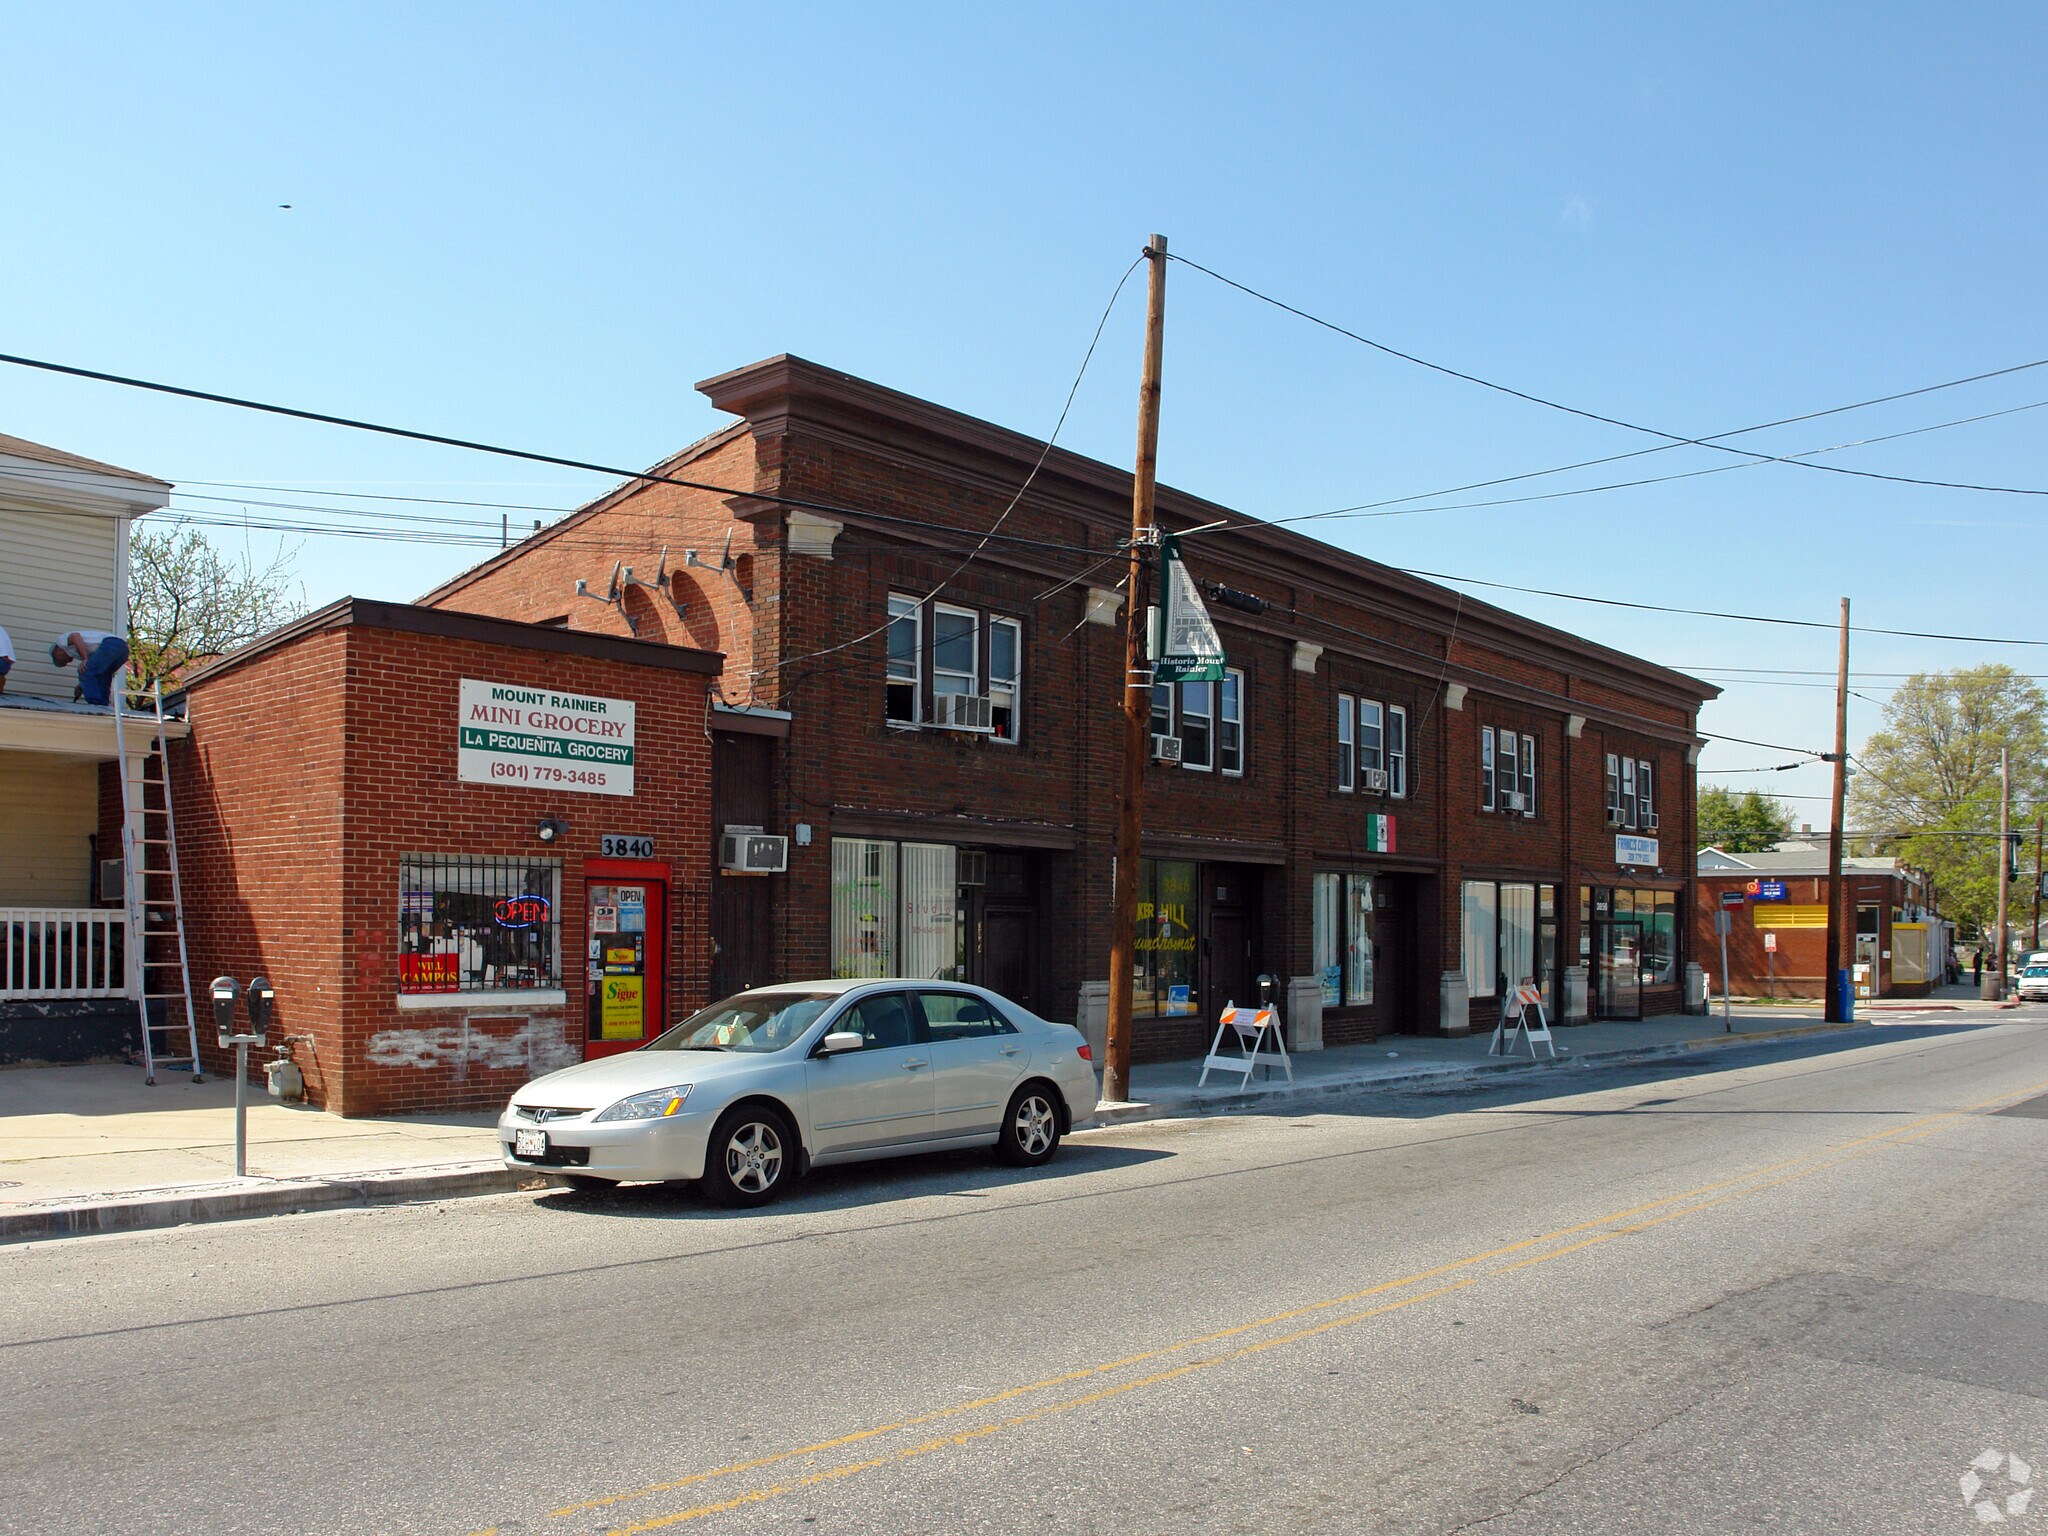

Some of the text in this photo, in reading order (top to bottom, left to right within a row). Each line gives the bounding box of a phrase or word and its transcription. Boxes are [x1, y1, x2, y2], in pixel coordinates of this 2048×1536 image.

[1160, 656, 1224, 665] Historic Mount
[1175, 665, 1207, 673] Rainier
[492, 688, 607, 714] MOUNT RAINIER
[470, 704, 627, 738] MINI GROCERY
[489, 732, 562, 754] PEQUEÑITA
[567, 742, 629, 761] GROCERY
[491, 762, 606, 786] (301) 779-3485
[603, 838, 653, 857] 3840
[620, 890, 641, 902] OPEN
[495, 900, 547, 922] OPEN
[1136, 902, 1189, 931] KER HILL
[402, 971, 458, 983] CAMPOS
[417, 961, 444, 971] WILL
[606, 981, 639, 1003] Sigue
